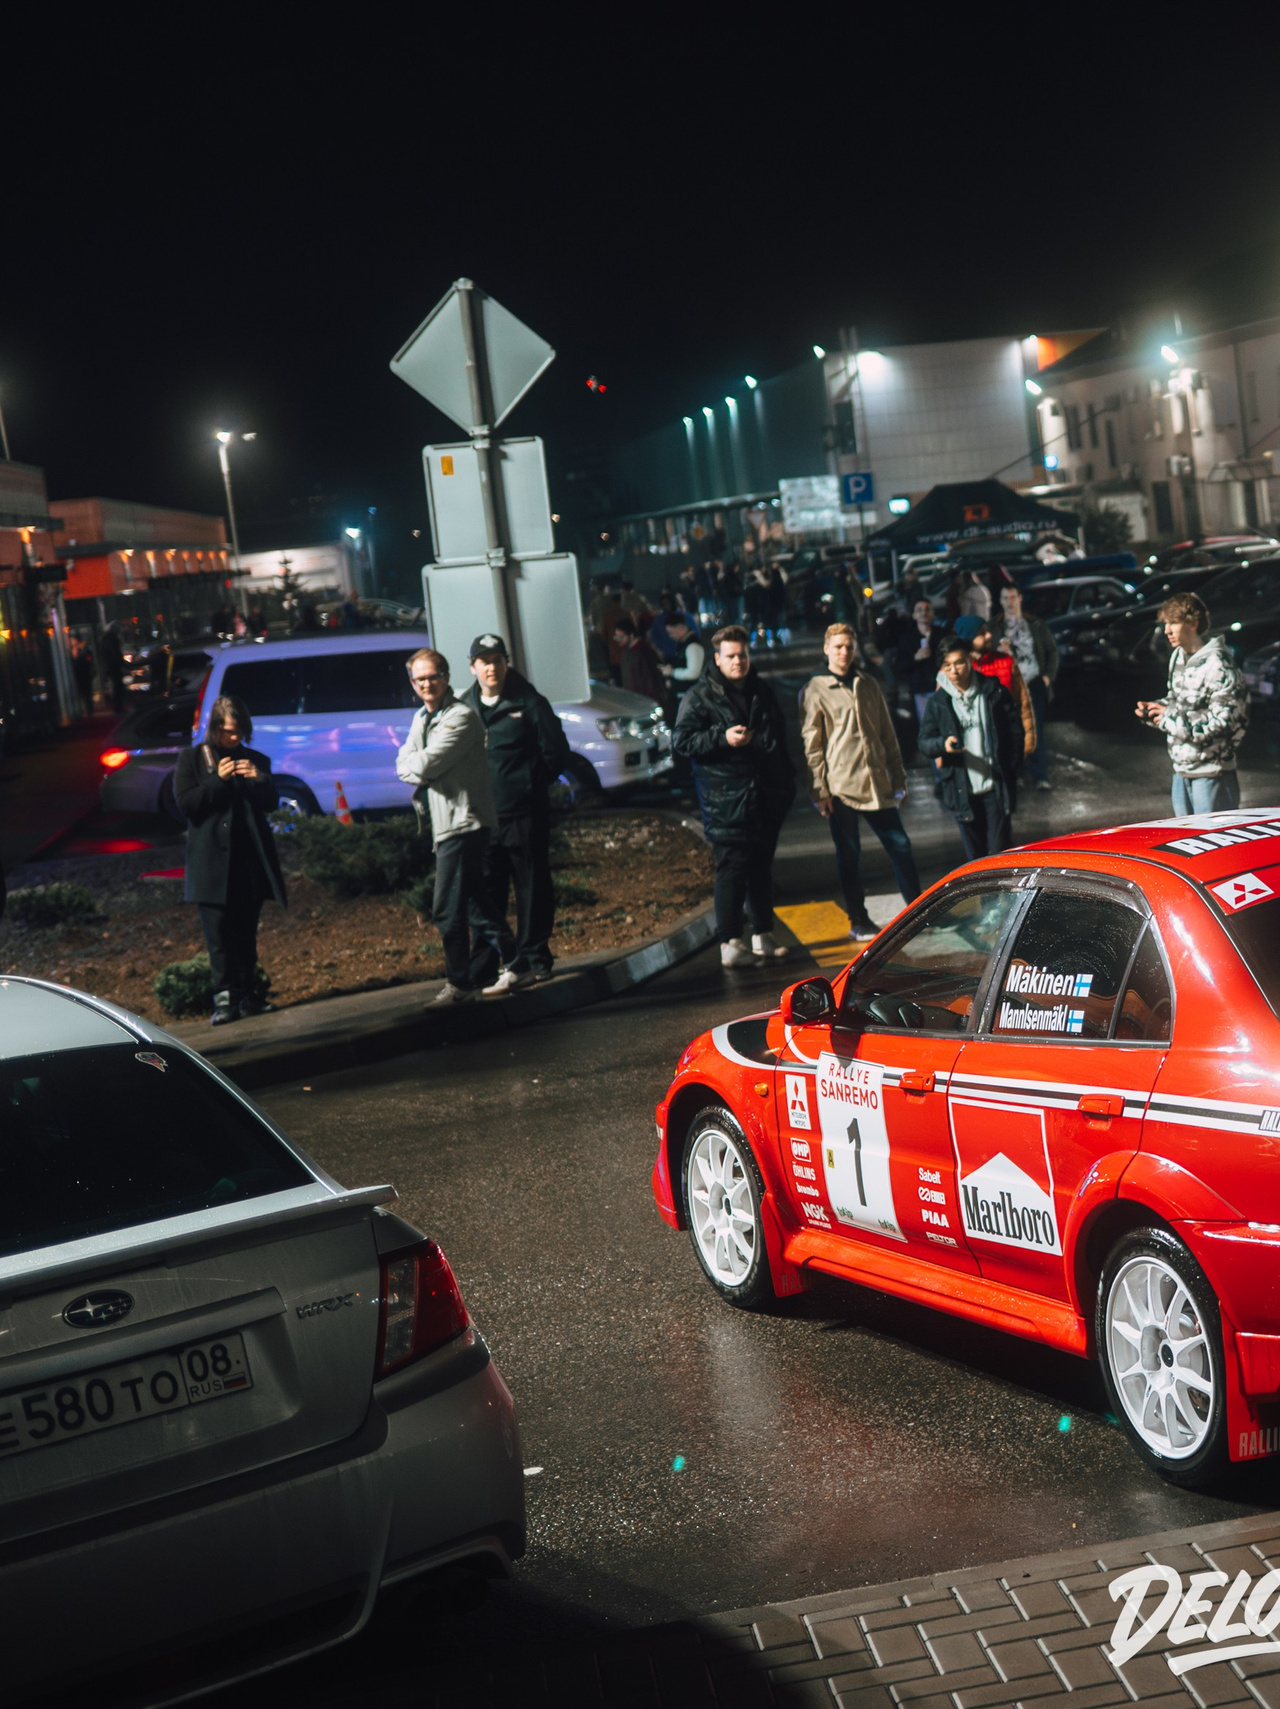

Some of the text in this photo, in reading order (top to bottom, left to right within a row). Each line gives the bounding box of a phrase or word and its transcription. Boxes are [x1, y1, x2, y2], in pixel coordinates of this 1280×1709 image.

[849, 476, 866, 502] P
[1006, 964, 1076, 997] Mäkinen
[829, 1063, 870, 1085] RALLYE
[821, 1079, 879, 1110] SANREMO
[793, 1162, 816, 1181] ÖHLINS
[847, 1117, 868, 1207] 1
[918, 1167, 941, 1184] Sabelt
[796, 1182, 819, 1197] brembo
[801, 1202, 829, 1222] NGK
[921, 1209, 950, 1228] PIAA
[961, 1184, 1055, 1248] Marlboro
[296, 1292, 355, 1319] WRX
[186, 1343, 231, 1381] 08
[190, 1379, 222, 1397] RUS
[1239, 1426, 1278, 1457] RALLI
